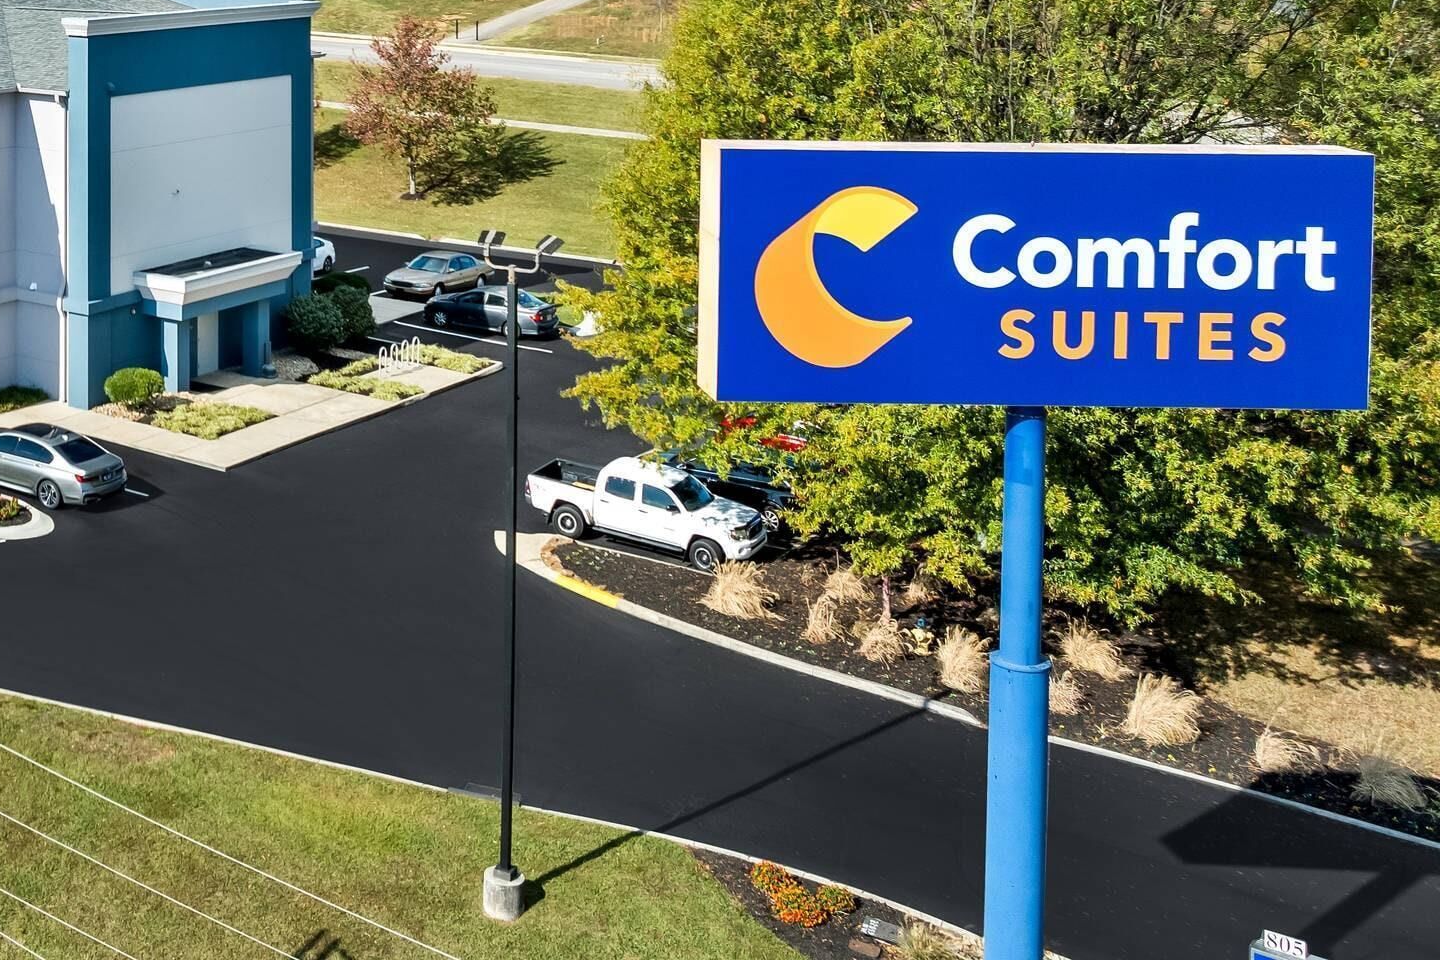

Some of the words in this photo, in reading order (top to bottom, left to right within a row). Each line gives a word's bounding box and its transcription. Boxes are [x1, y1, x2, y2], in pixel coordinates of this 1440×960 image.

[952, 211, 1337, 292] Comfort
[997, 308, 1288, 364] SUITES
[1266, 932, 1304, 957] 805
